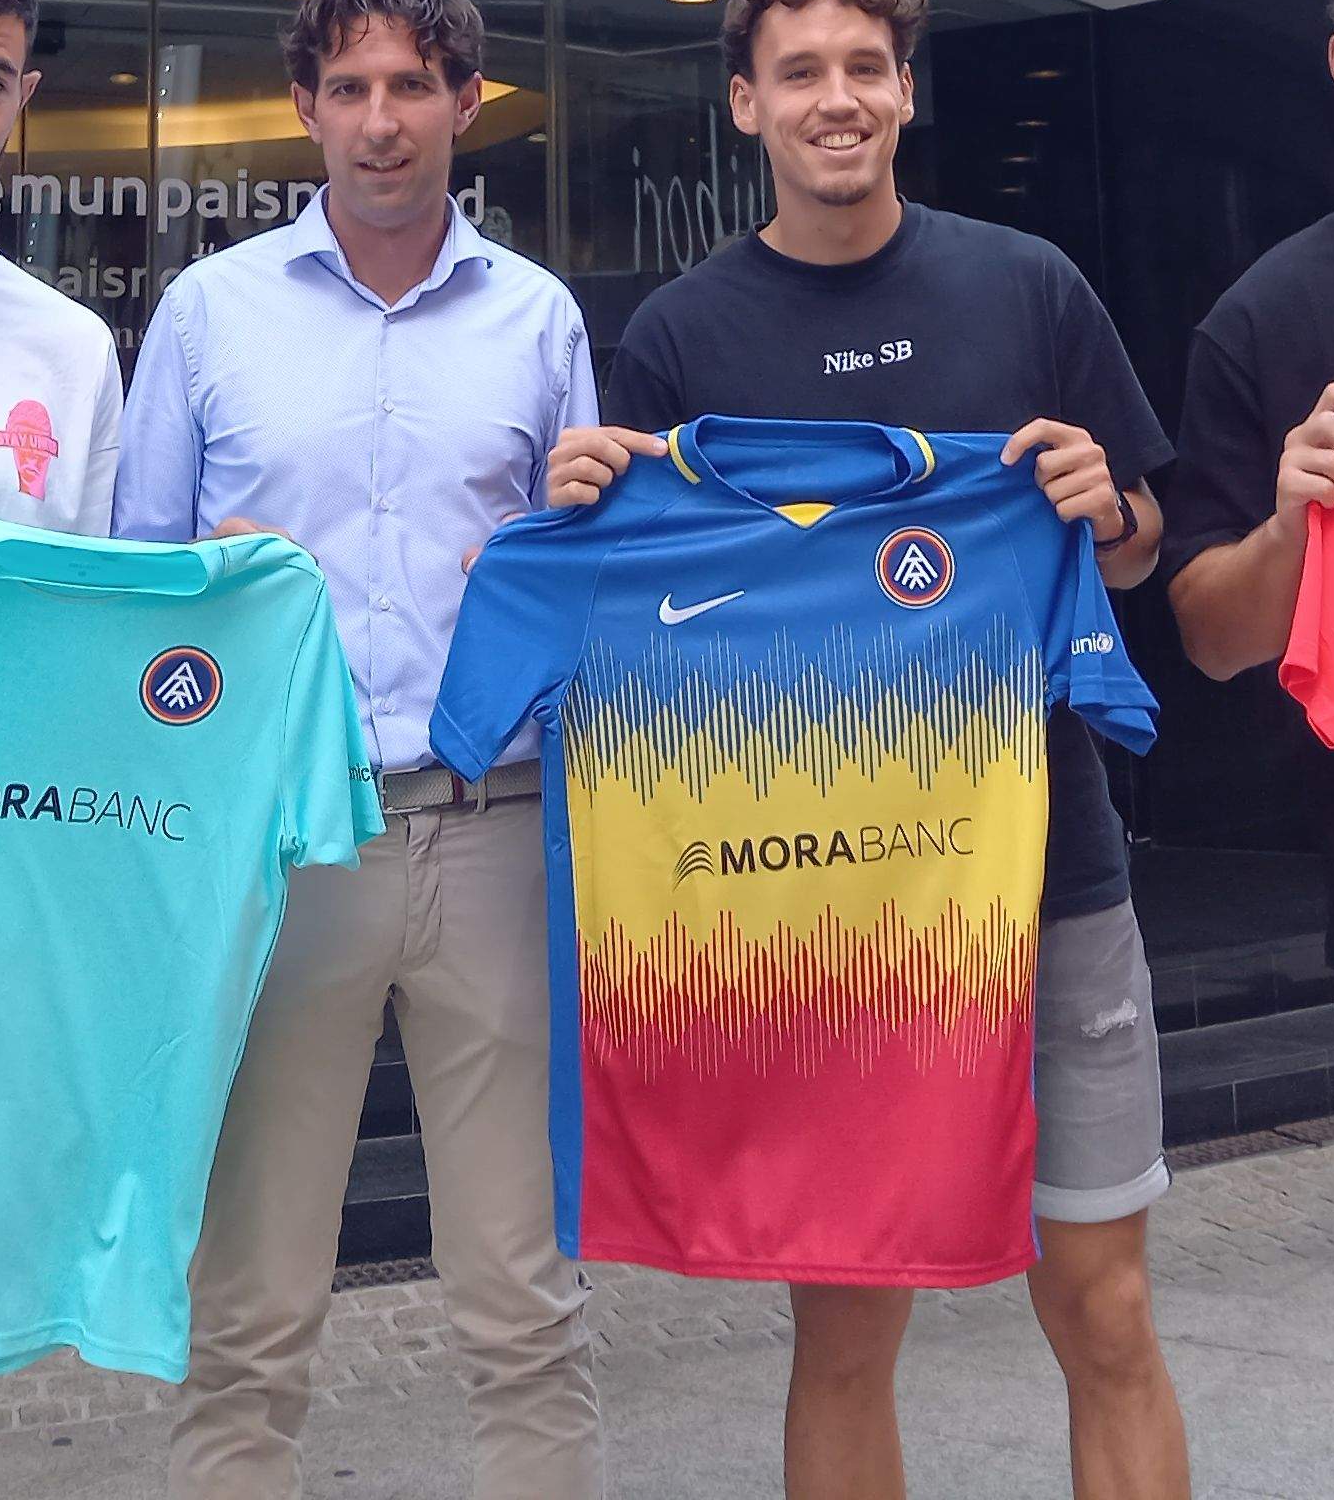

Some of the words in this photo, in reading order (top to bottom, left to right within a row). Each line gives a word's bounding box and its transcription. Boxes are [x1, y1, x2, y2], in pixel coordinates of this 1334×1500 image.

[823, 349, 874, 374] Nike
[879, 339, 913, 364] SB
[720, 817, 974, 876] MORABANC
